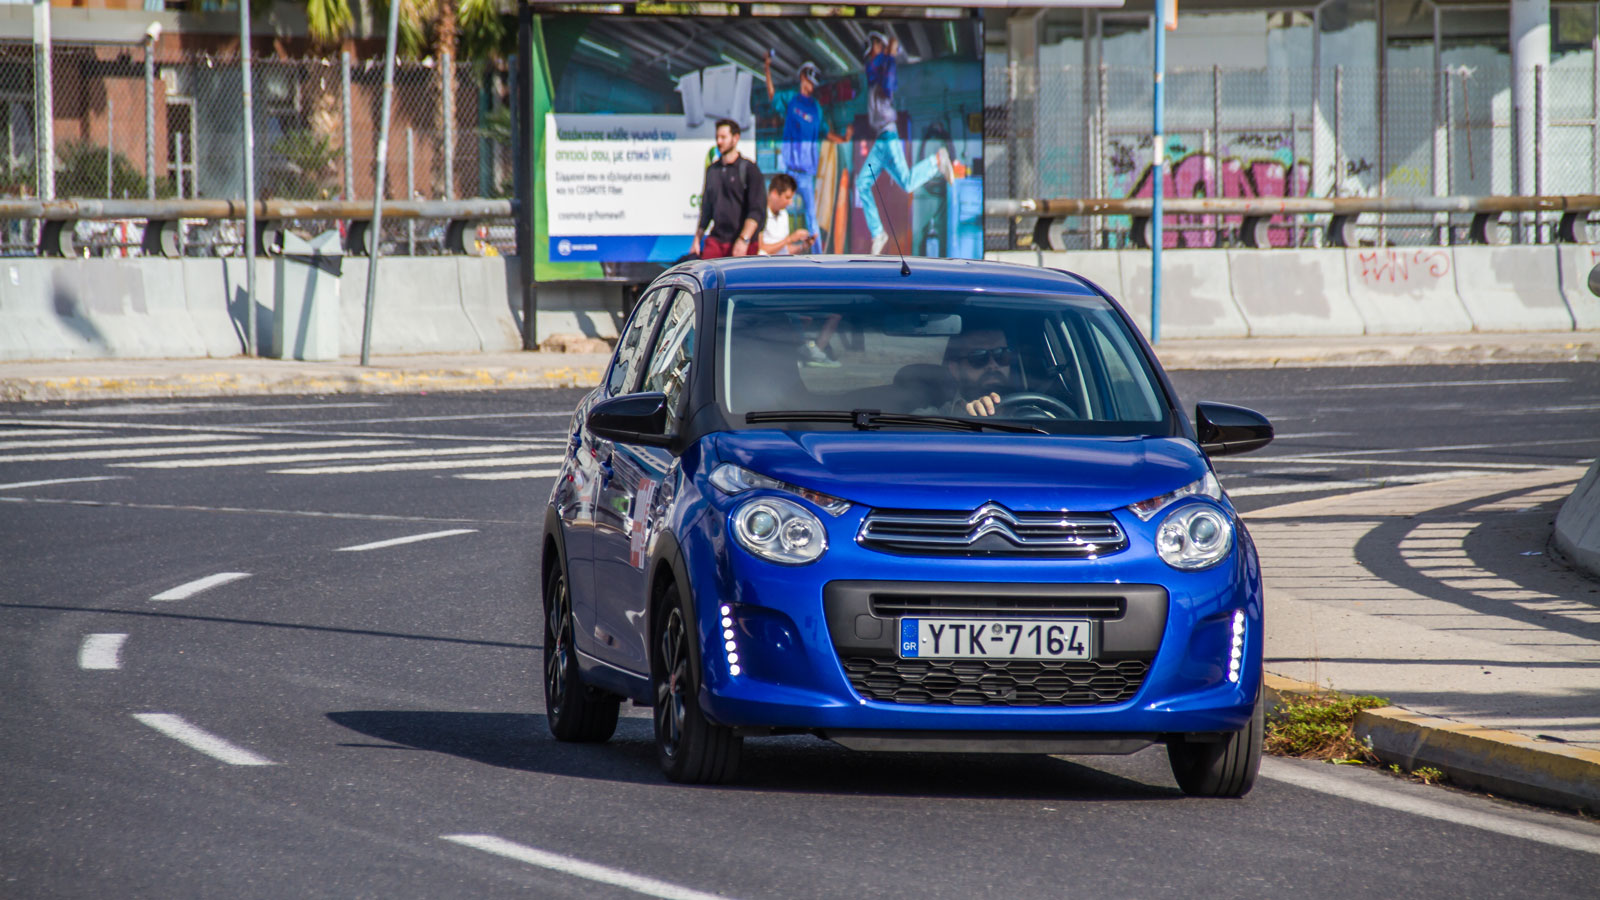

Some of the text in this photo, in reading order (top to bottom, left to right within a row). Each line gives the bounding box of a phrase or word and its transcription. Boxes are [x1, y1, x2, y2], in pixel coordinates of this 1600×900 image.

[661, 130, 676, 141] του
[555, 146, 588, 161] σπιτιού
[613, 151, 623, 164] με
[627, 148, 650, 161] επικό
[576, 185, 606, 195] COSMOTE
[903, 623, 1085, 656] GR YTK-7164
